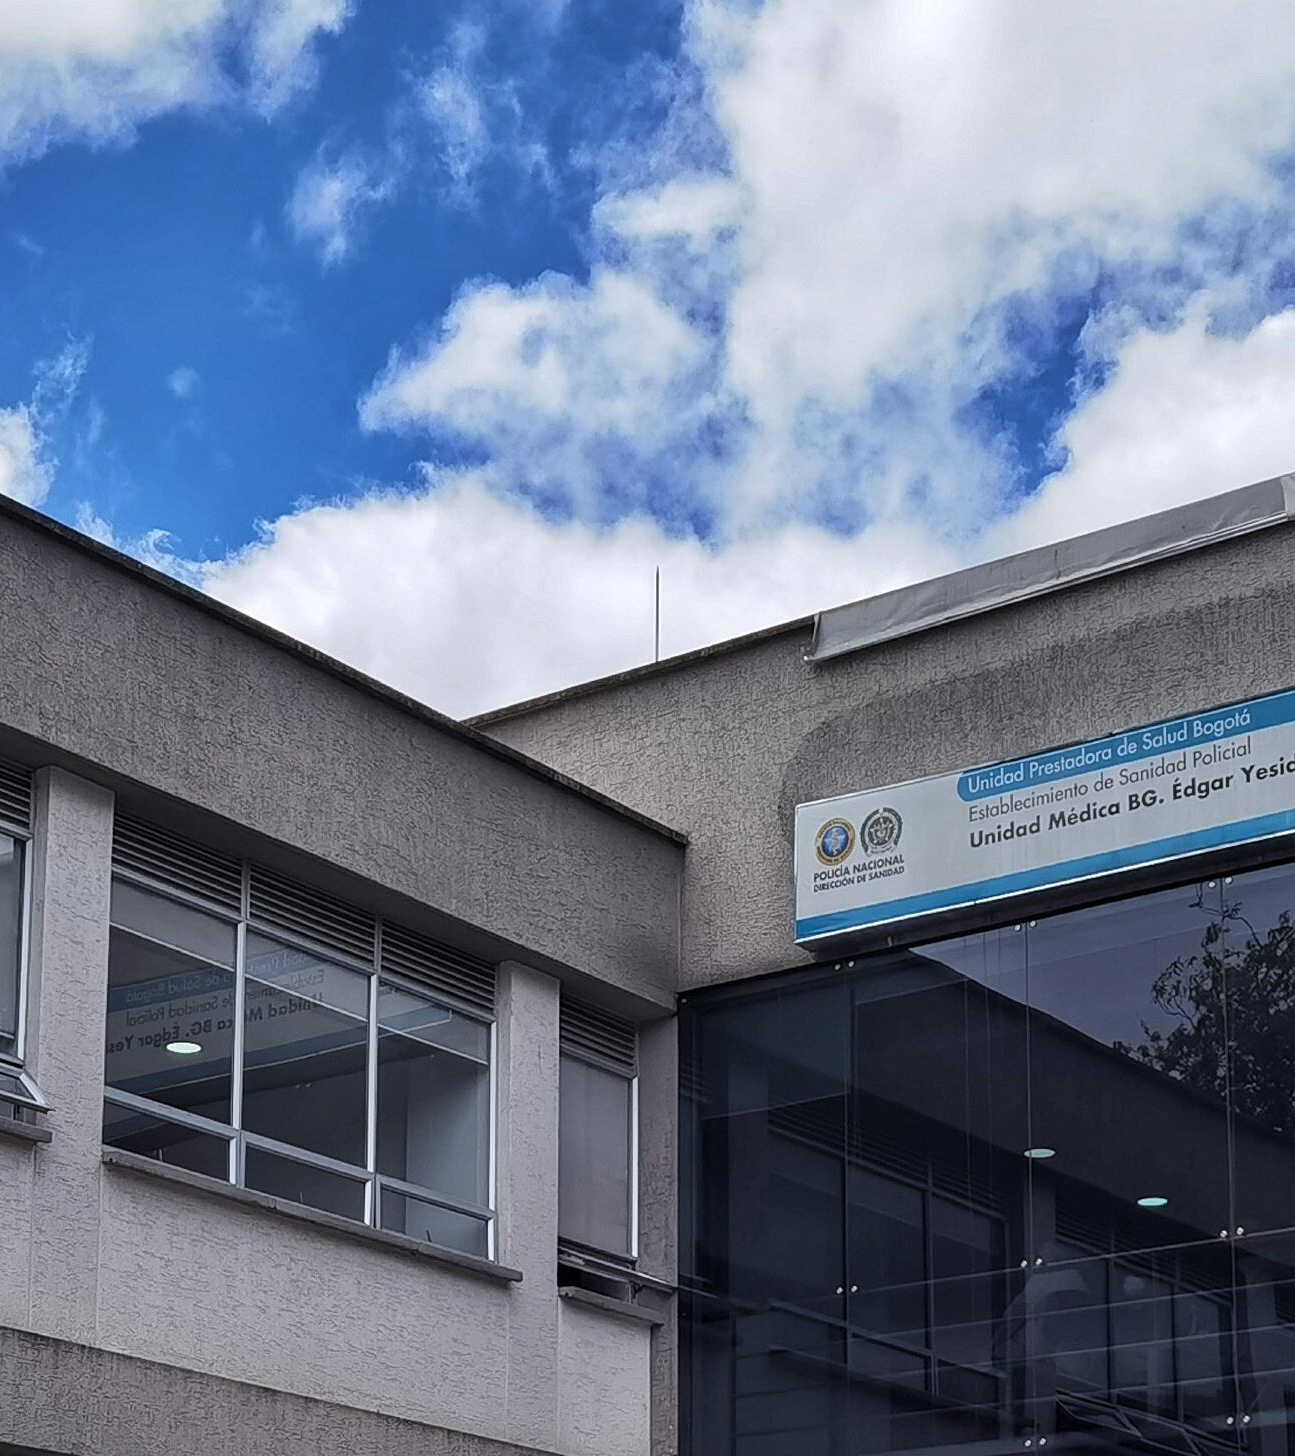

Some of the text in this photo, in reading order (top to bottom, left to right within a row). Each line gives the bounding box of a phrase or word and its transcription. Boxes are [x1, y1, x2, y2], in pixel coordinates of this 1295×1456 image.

[968, 708, 1251, 793] Unidad Prestadora de Salud Bogotá
[969, 735, 1252, 822] Establecimiento de Sanidad Policial
[970, 815, 1041, 848] Unidad
[1048, 802, 1121, 831] Médica
[1128, 790, 1165, 811] BG.
[1172, 774, 1235, 800] Édgar
[813, 854, 905, 883] POLICÍA NACIONAL
[813, 865, 905, 893] DIRECCIÓN DE SANIDAD
